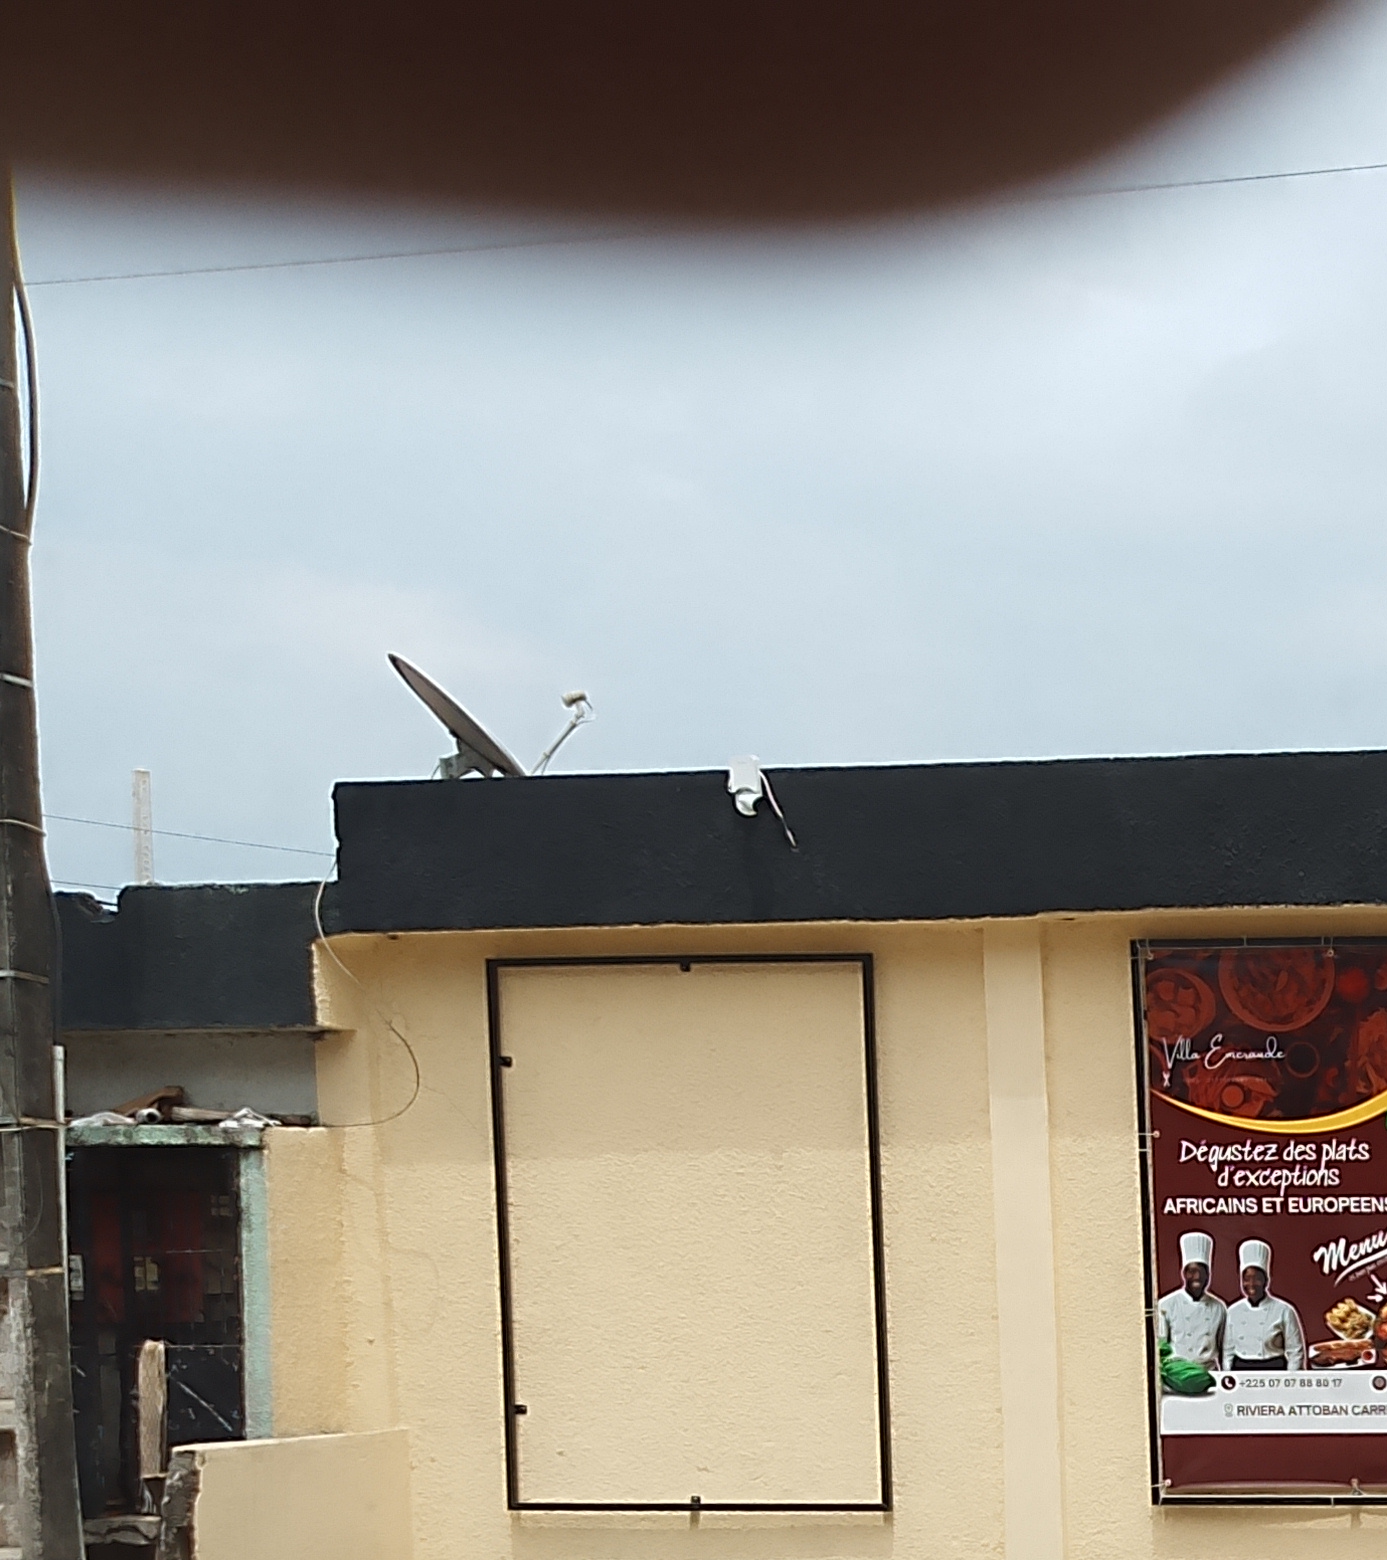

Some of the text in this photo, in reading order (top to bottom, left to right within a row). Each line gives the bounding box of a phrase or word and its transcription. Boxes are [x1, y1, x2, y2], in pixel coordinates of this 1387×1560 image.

[1161, 1033, 1286, 1069] Villa Emeraude
[1179, 1138, 1370, 1172] Dégustez des plats
[1217, 1164, 1340, 1197] d'exceptions
[1164, 1197, 1258, 1214] AFRICAINS
[1262, 1197, 1285, 1213] ET
[1240, 1379, 1265, 1387] +225
[1268, 1379, 1281, 1387] 07
[1284, 1379, 1297, 1387] 07
[1331, 1378, 1343, 1387] 17
[1237, 1405, 1285, 1416] RIVIERA
[1288, 1404, 1348, 1416] ATTOBAN
